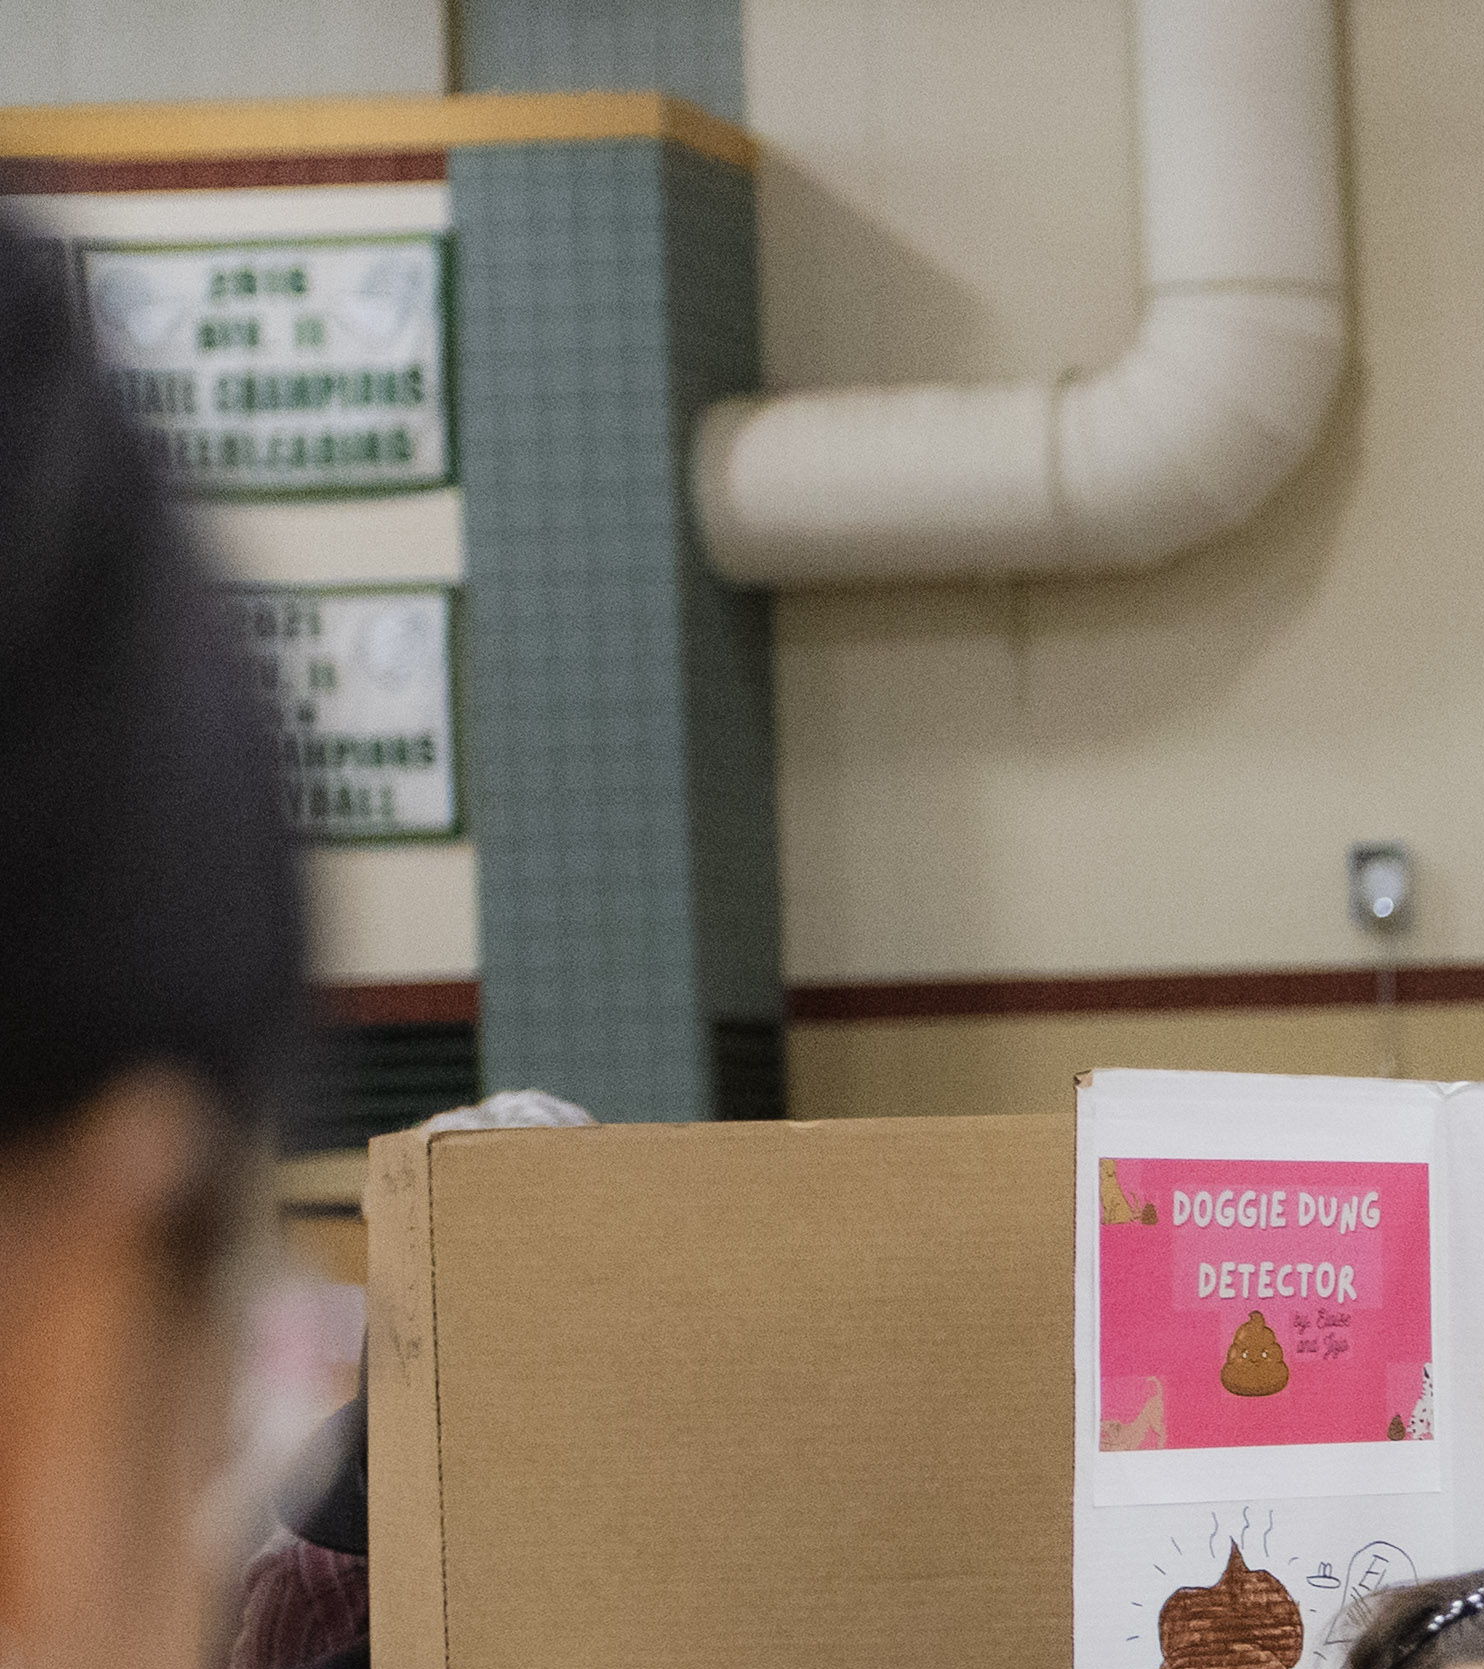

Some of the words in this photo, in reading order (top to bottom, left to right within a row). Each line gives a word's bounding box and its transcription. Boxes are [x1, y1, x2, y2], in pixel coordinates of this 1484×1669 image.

[1172, 1190, 1286, 1229] DOGGIE
[1298, 1190, 1381, 1234] DUNG
[1199, 1260, 1357, 1303] DETECTOR
